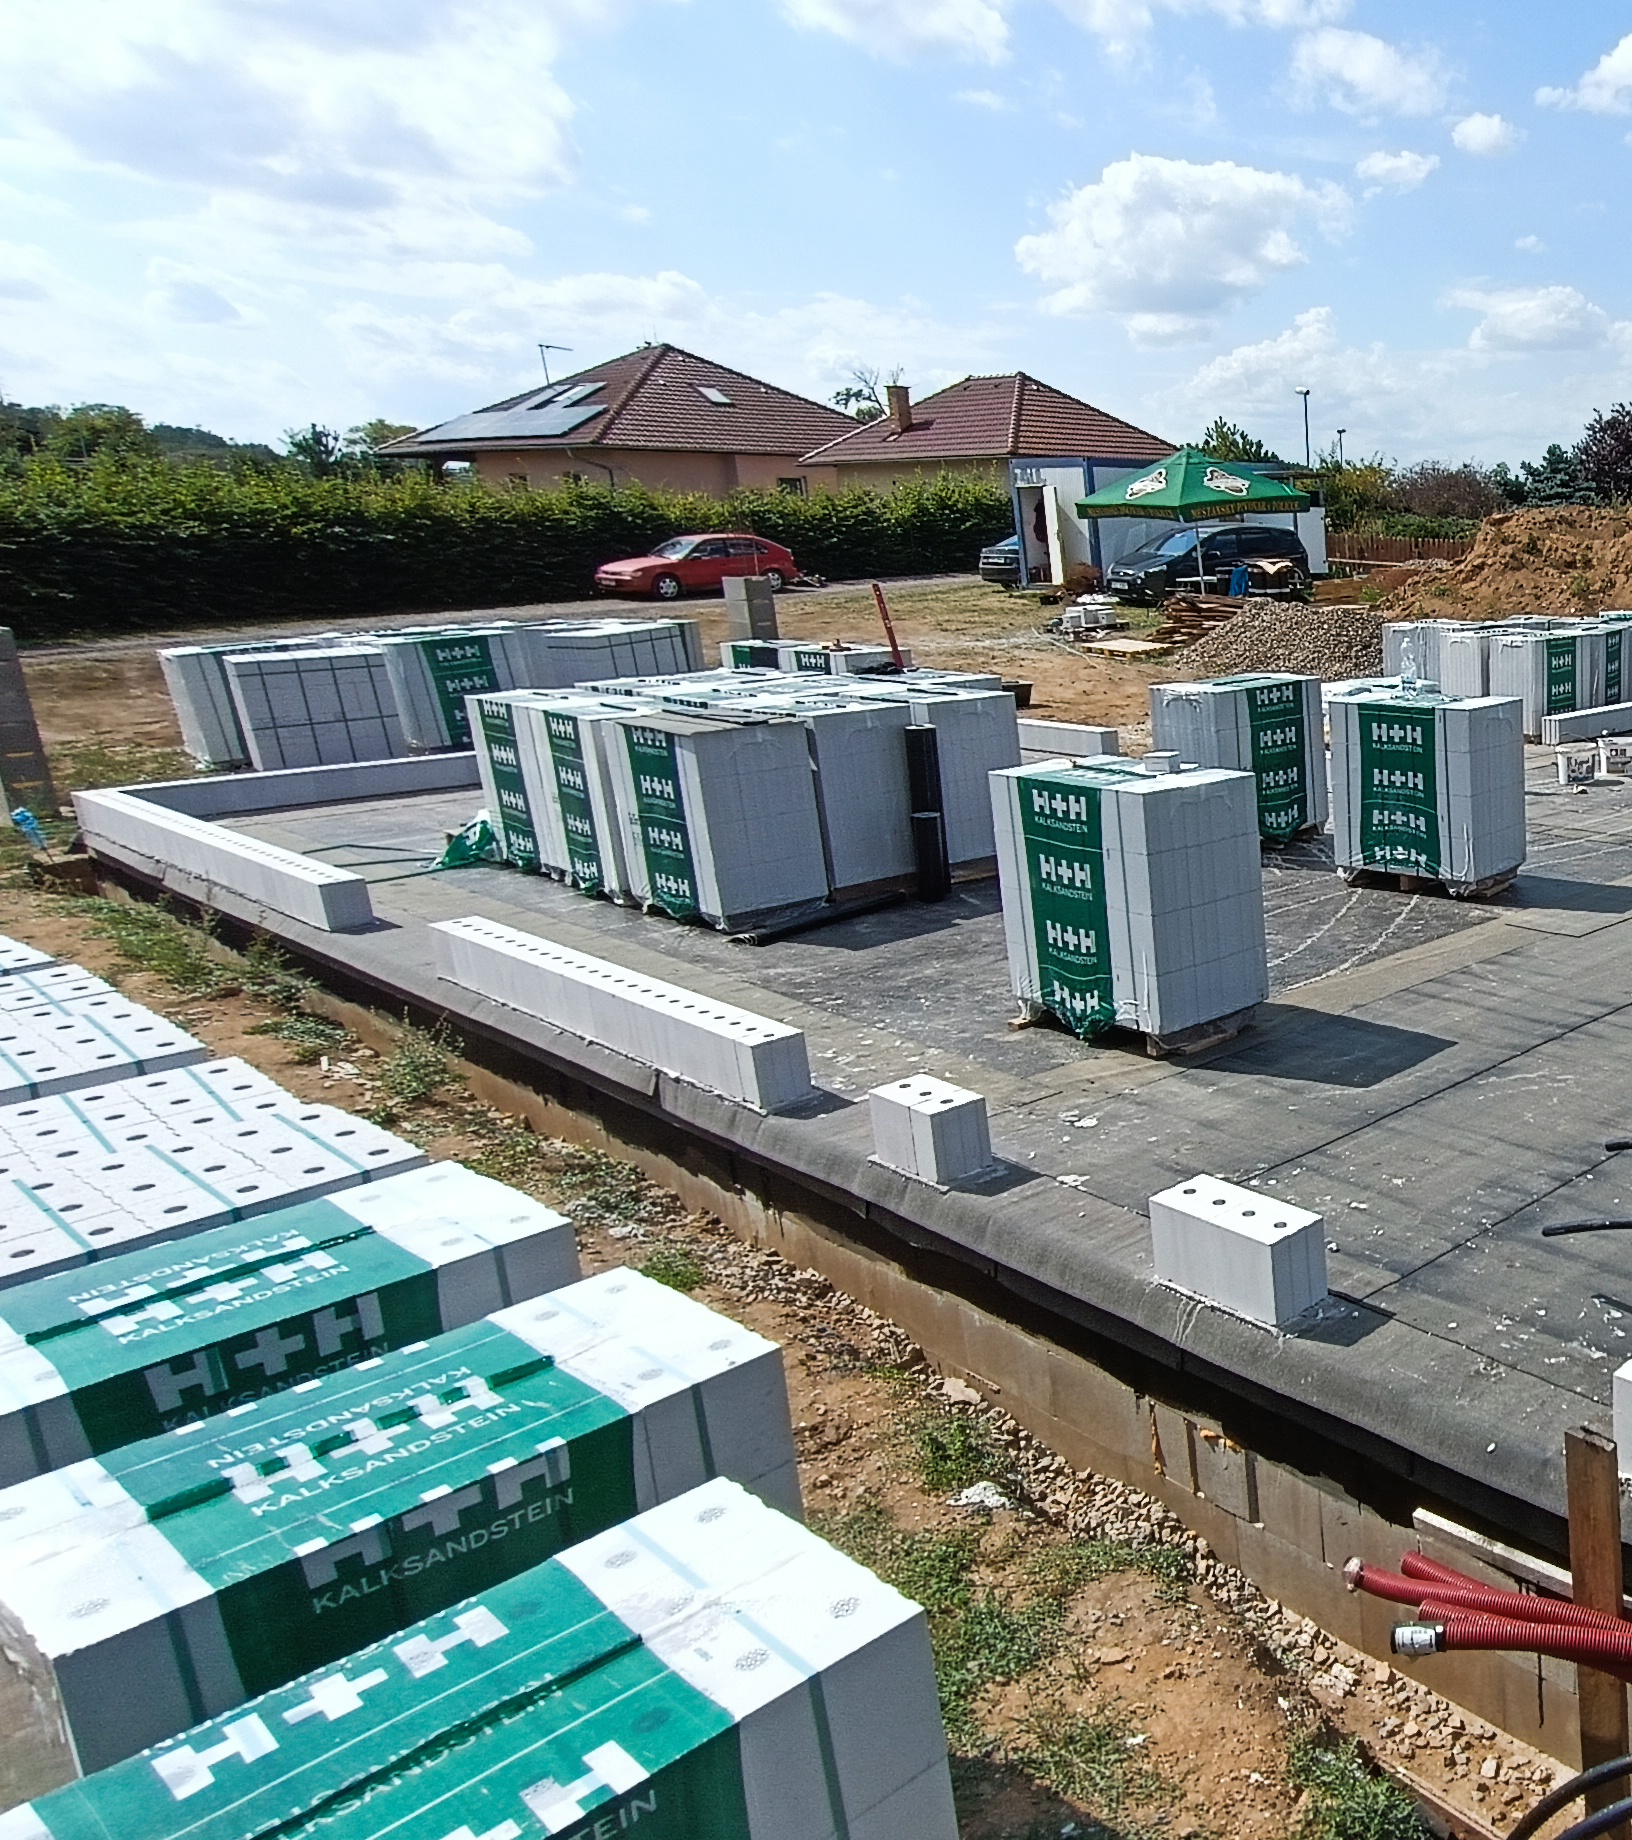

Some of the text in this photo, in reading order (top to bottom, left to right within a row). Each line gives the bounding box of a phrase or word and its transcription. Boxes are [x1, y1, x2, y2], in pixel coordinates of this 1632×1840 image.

[436, 645, 480, 661] H+H
[800, 654, 825, 668] H+H
[1552, 654, 1571, 668] H+H
[446, 676, 488, 692] H+H
[1256, 685, 1293, 705] H+H
[1552, 682, 1571, 696] H+H
[484, 700, 508, 719] H+H
[550, 717, 575, 739] H+H
[632, 726, 667, 747] H+H
[1260, 727, 1296, 747] H+H
[1372, 722, 1422, 744] H+H
[491, 743, 517, 765] H+H
[559, 766, 584, 790] H+H
[640, 775, 675, 799] H+H
[1262, 767, 1298, 788] H+H
[1373, 768, 1424, 791] H+H
[501, 789, 526, 812] H+H
[1032, 789, 1087, 821] H+H
[567, 813, 591, 835] H+H
[1034, 815, 1088, 834] KALKSANDSTEIN
[1264, 804, 1299, 828] H+H
[1372, 809, 1426, 831] H+H
[509, 831, 534, 851] H+H
[649, 827, 683, 850] H+H
[1375, 845, 1428, 868] H+H
[574, 858, 599, 879] H+H
[1039, 854, 1092, 889] H+H
[655, 873, 691, 897] H+H
[1041, 881, 1093, 901] KALKSANDSTEIN
[1046, 920, 1097, 954] H+H
[1053, 980, 1099, 1014] H+H
[68, 1229, 299, 1303] KALKSANDSTEIN
[99, 1250, 339, 1337] H+H
[118, 1265, 351, 1345] KALKSANDSTEIN
[144, 1292, 384, 1413] H+H
[208, 1366, 472, 1468] KALKSANDSTEIN
[221, 1375, 505, 1504] H+H
[250, 1400, 521, 1517] KALKSANDSTEIN
[293, 1436, 571, 1590] H+H
[312, 1488, 574, 1614] KALKSANDSTEIN
[151, 1605, 511, 1800] H+H
